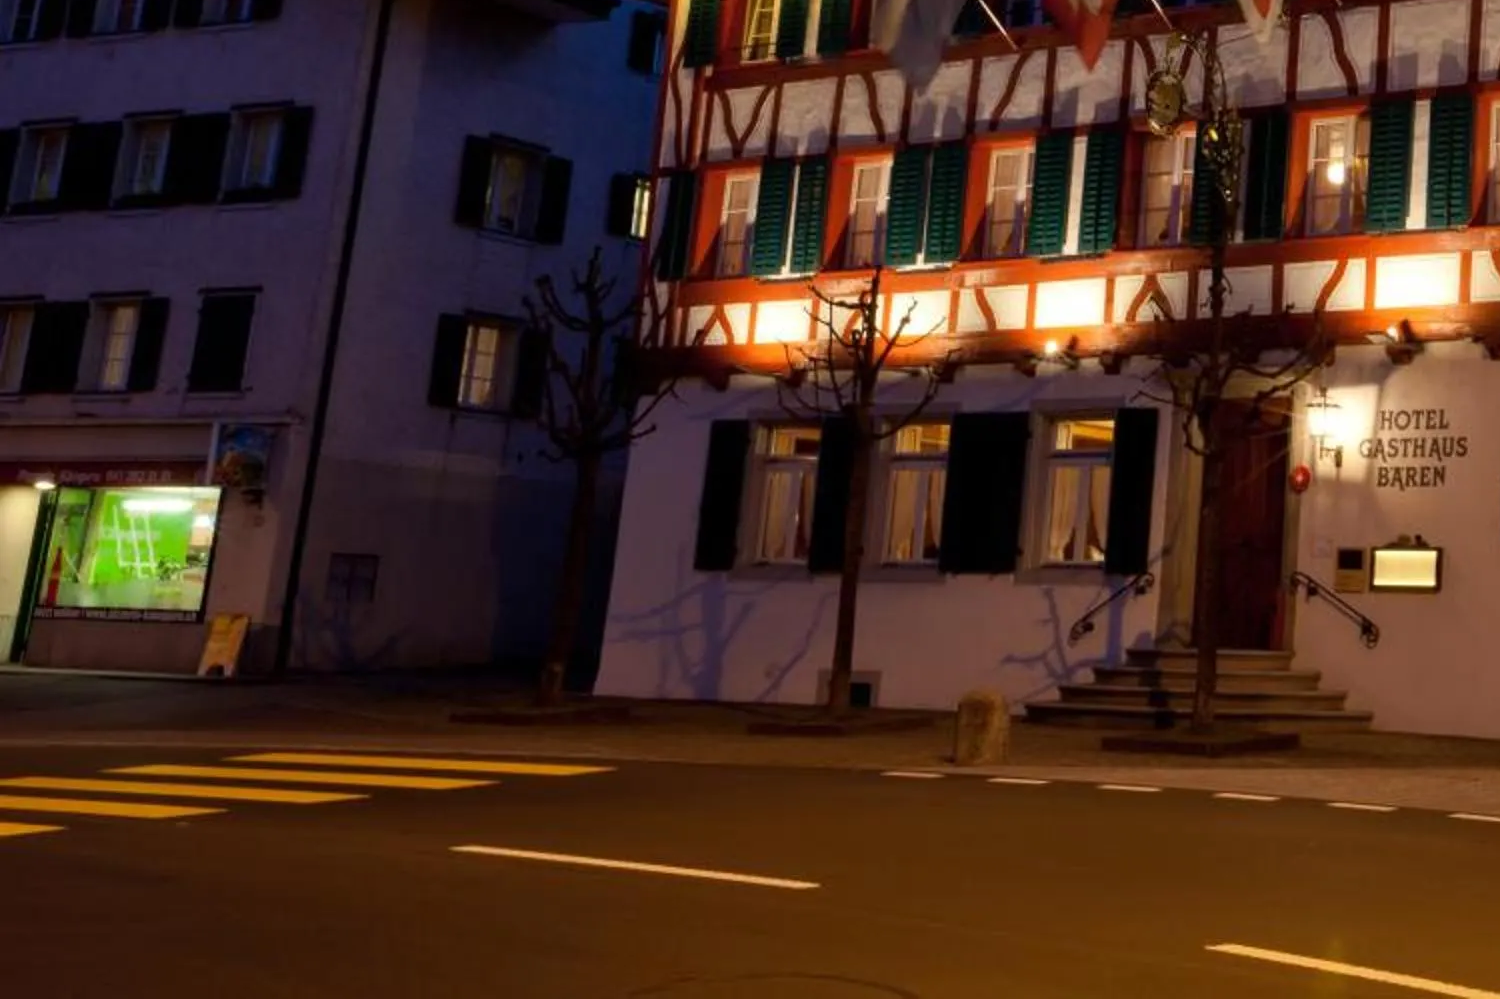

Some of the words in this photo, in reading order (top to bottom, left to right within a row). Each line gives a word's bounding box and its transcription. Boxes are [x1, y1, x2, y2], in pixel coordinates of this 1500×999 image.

[1378, 408, 1450, 431] HOTEL
[1358, 435, 1469, 463] GASTHAUS
[1375, 464, 1447, 492] BÄREN
